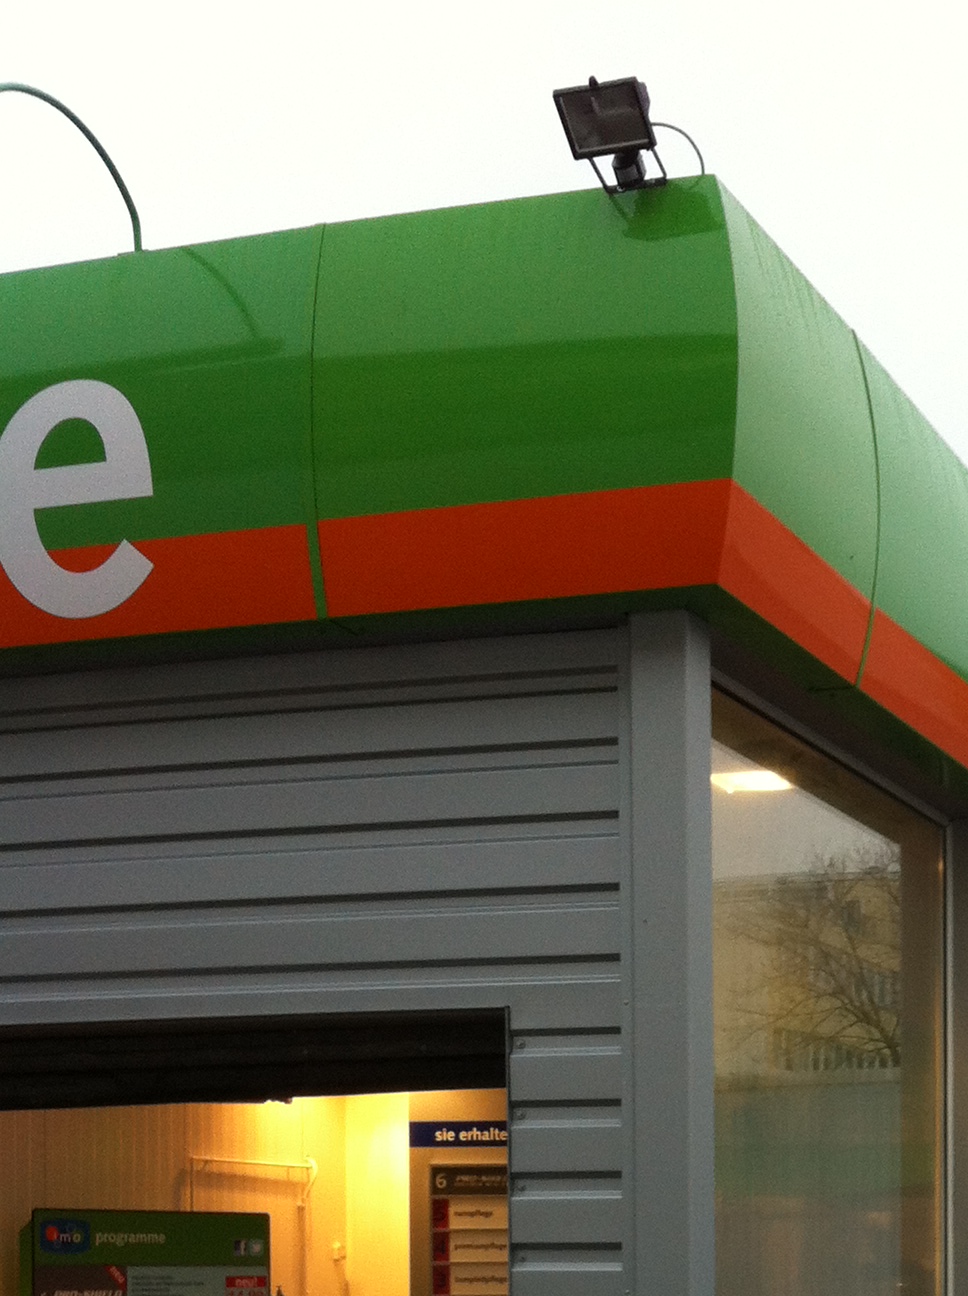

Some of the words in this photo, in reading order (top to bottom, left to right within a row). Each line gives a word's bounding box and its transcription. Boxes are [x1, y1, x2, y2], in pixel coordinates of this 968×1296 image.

[0, 379, 154, 619] e
[435, 1128, 455, 1141] sie
[459, 1127, 508, 1141] erhalte
[435, 1173, 447, 1188] 6
[53, 1229, 82, 1244] imo
[95, 1232, 166, 1247] programme
